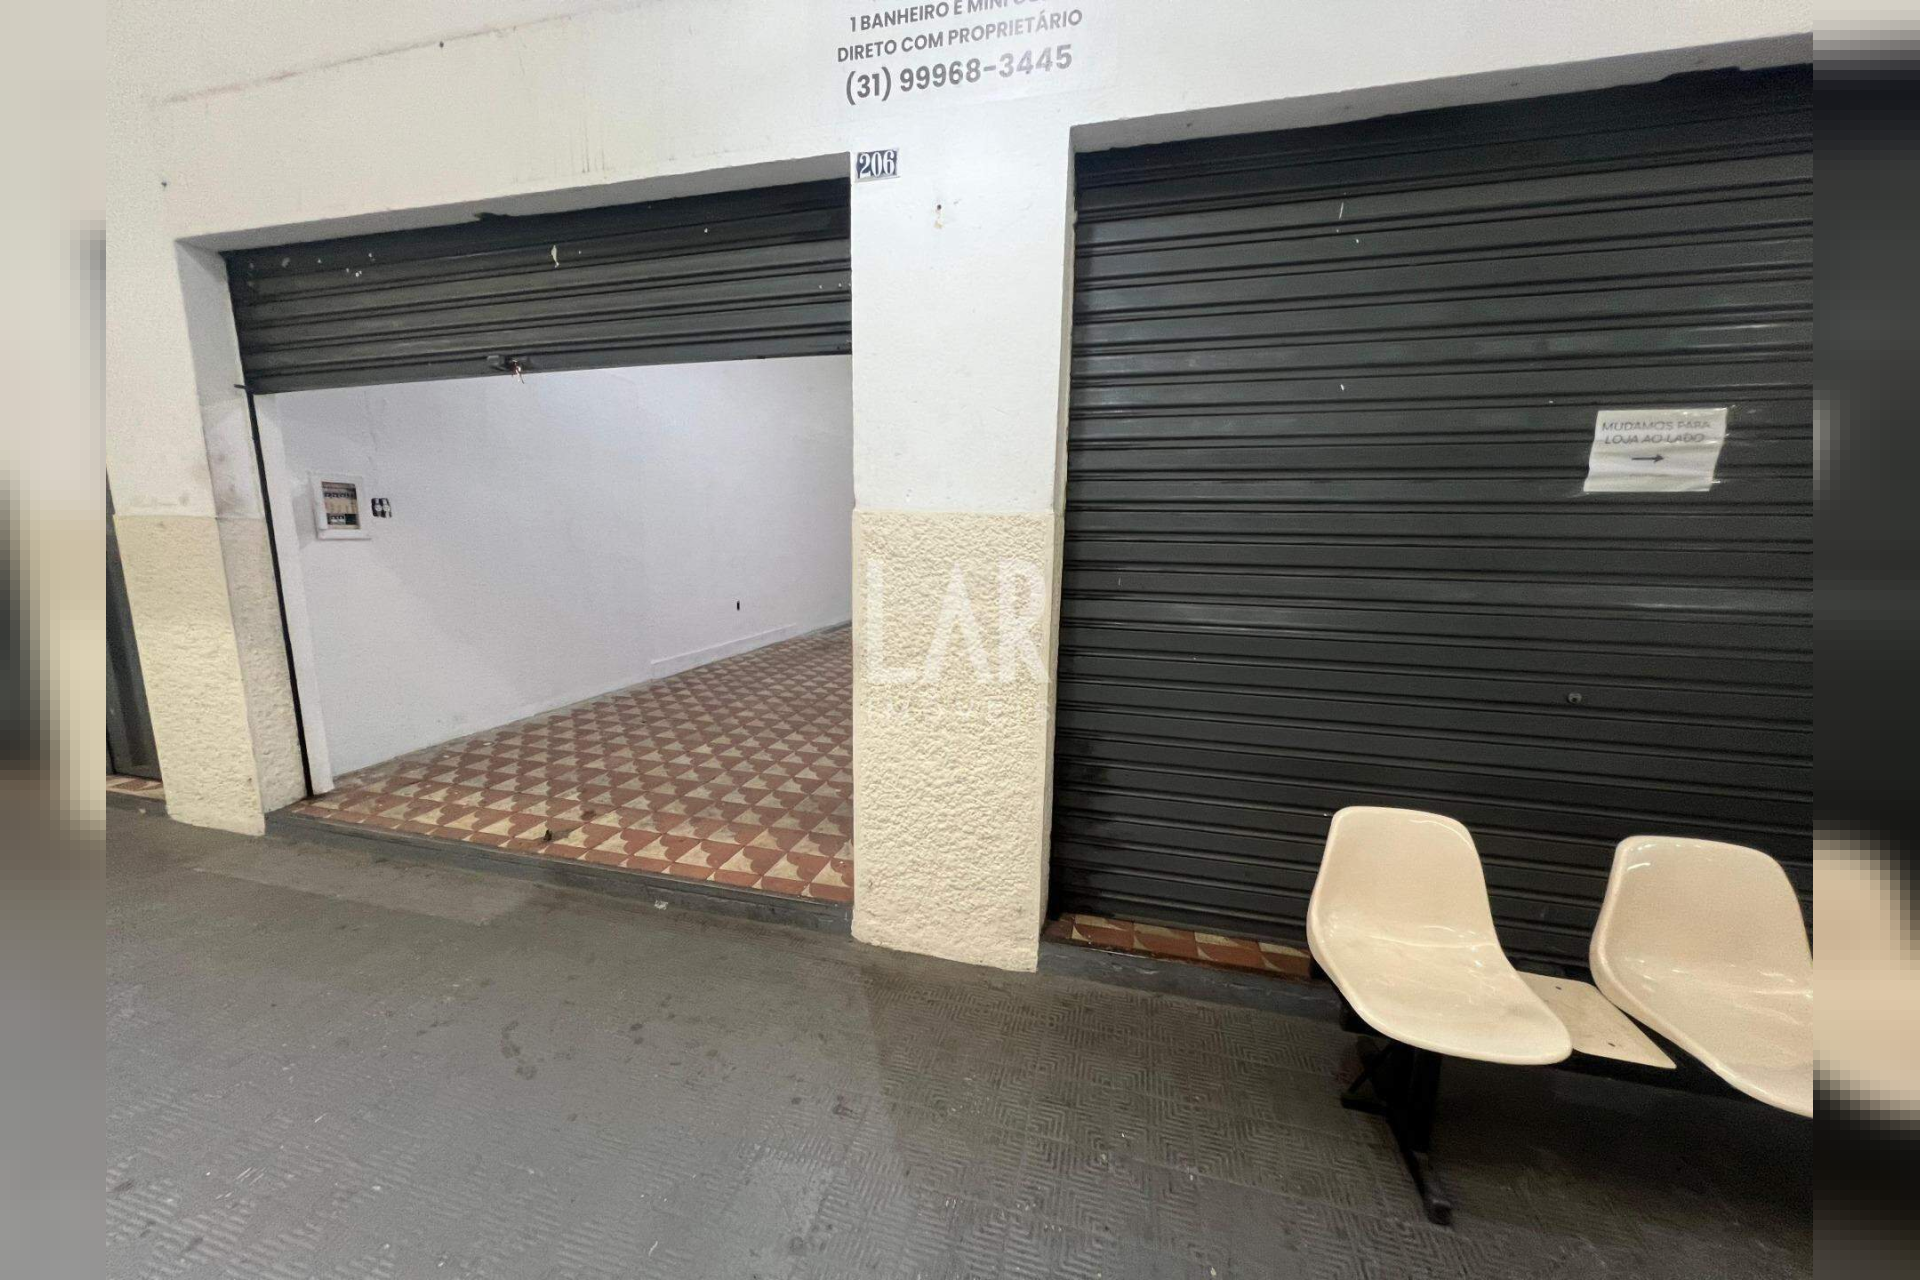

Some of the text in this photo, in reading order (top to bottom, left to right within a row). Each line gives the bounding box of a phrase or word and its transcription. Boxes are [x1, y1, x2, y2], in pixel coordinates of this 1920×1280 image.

[850, 16, 856, 32] 1
[861, 2, 950, 31] BANHEIRO
[953, 0, 963, 15] E
[838, 9, 1083, 63] DIRETO COM PROPRIETÁRIO
[845, 44, 1073, 105] (31) 99968-3445
[859, 150, 896, 178] 206
[1601, 420, 1711, 432] MUDAMOS PARA
[1604, 433, 1705, 444] LOJA AO LADO
